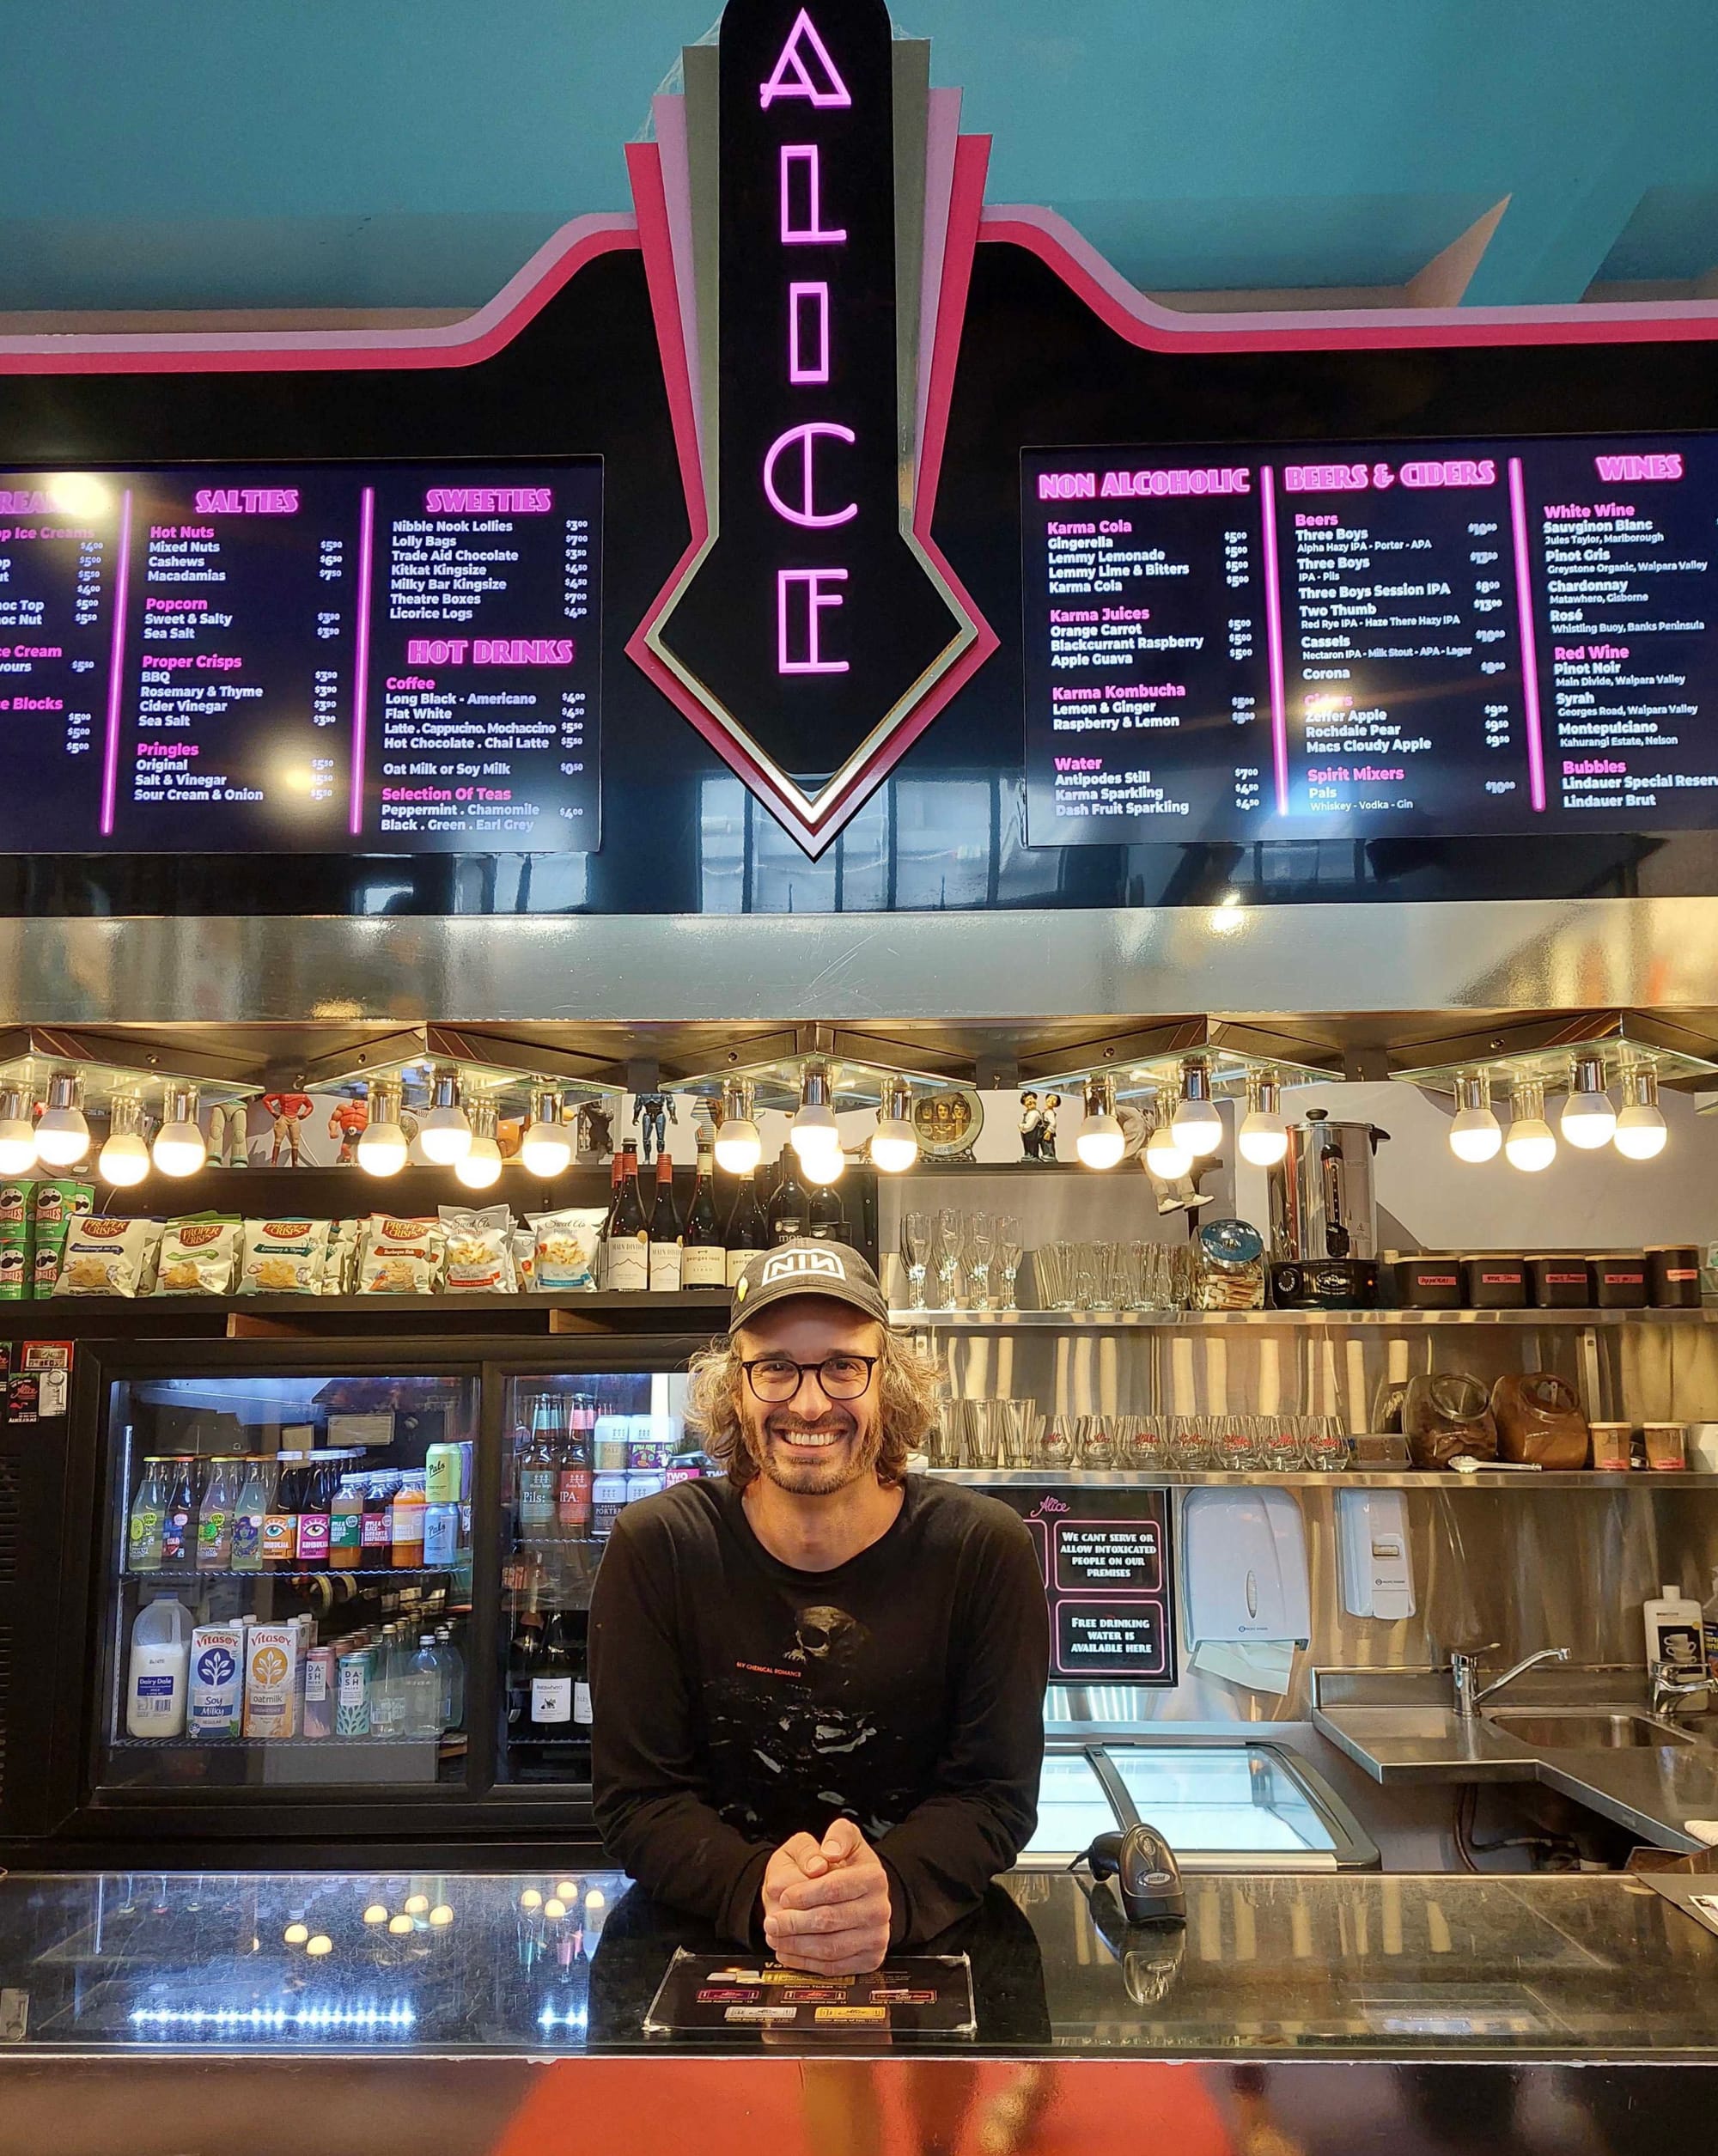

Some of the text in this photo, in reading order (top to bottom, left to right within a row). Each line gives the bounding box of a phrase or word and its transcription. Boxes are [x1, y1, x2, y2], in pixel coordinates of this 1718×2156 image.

[760, 7, 858, 673] ALICE
[1594, 454, 1682, 481] WINES
[1284, 460, 1496, 491] BEERS & CIDERS
[1039, 468, 1250, 499] NON ALCOHOLIC
[195, 490, 298, 513] SALTIES
[426, 489, 551, 512] SWEETIES
[1544, 503, 1635, 519] White Wine
[150, 526, 214, 539] Hot Nuts
[393, 520, 513, 533] Nibble Nook Lollies
[1047, 519, 1131, 535] Karma Cola
[149, 540, 220, 553] Mixed Nuts
[392, 535, 456, 549] Lolly Bags
[1047, 536, 1113, 551] Gingerella
[148, 556, 204, 567] Cashews
[391, 548, 518, 561] Trade Aid Chocolate
[1048, 549, 1165, 565] Lemmy Lemonade
[1545, 547, 1611, 562] Pinot Gris
[147, 569, 226, 582] Macadamias
[391, 563, 487, 577] Kitkat Kingsize
[1298, 582, 1451, 600] Three Boys Session IPA
[1547, 580, 1628, 594] Chardonnay
[146, 598, 207, 612] Popcorn
[389, 593, 480, 605] Theatre Boxes
[390, 606, 472, 622] Licorice Logs
[1299, 603, 1376, 618] Two Thumb
[1550, 608, 1583, 622] Rosé
[143, 627, 194, 639] Sea Salt
[1050, 624, 1142, 639] Orange Carrot
[1051, 636, 1203, 652] Blackcurrant Raspberry
[1301, 635, 1350, 649] Cassels
[407, 640, 572, 664] HOT DRINKS
[143, 654, 241, 671] Proper Crisps
[1051, 653, 1133, 668] Apple Guava
[1302, 668, 1350, 680] Corona
[386, 676, 435, 690] Coffee
[140, 685, 263, 699] Rosemary & Thyme
[139, 699, 228, 715] Cider Vinegar
[385, 707, 452, 720] Flat White
[1306, 724, 1401, 738] Rochdale Pear
[1557, 721, 1658, 736] Montepulciano
[137, 742, 198, 758] Pringles
[136, 758, 187, 773] Original
[383, 761, 510, 777] Oat Milk or Soy Milk
[1054, 758, 1102, 770] Water
[382, 786, 511, 801] Selection Of Teas
[182, 1227, 220, 1239] PROPER
[386, 1221, 428, 1233] PROPER
[186, 1234, 211, 1245] CRISPS
[429, 1460, 445, 1477] Pals
[667, 1471, 688, 1480] TWO
[1031, 1495, 1071, 1518] Alice
[428, 1522, 445, 1538] Pals
[1081, 1533, 1106, 1542] CANT
[1109, 1533, 1136, 1543] SERVE
[1139, 1534, 1154, 1543] OR
[1060, 1544, 1157, 1556] ALLOW INTOXICATED
[1072, 1556, 1145, 1566] PEOPLE ON OUR
[1087, 1568, 1130, 1577] PREMISES
[1100, 1619, 1149, 1629] DRINKING
[1087, 1631, 1135, 1641] WATER IS
[1070, 1643, 1152, 1654] AVAILABLE HERE
[139, 1678, 156, 1686] Dairy
[205, 1696, 222, 1707] Soy
[253, 1695, 283, 1704] oatmilk
[200, 1706, 225, 1717] Milky
